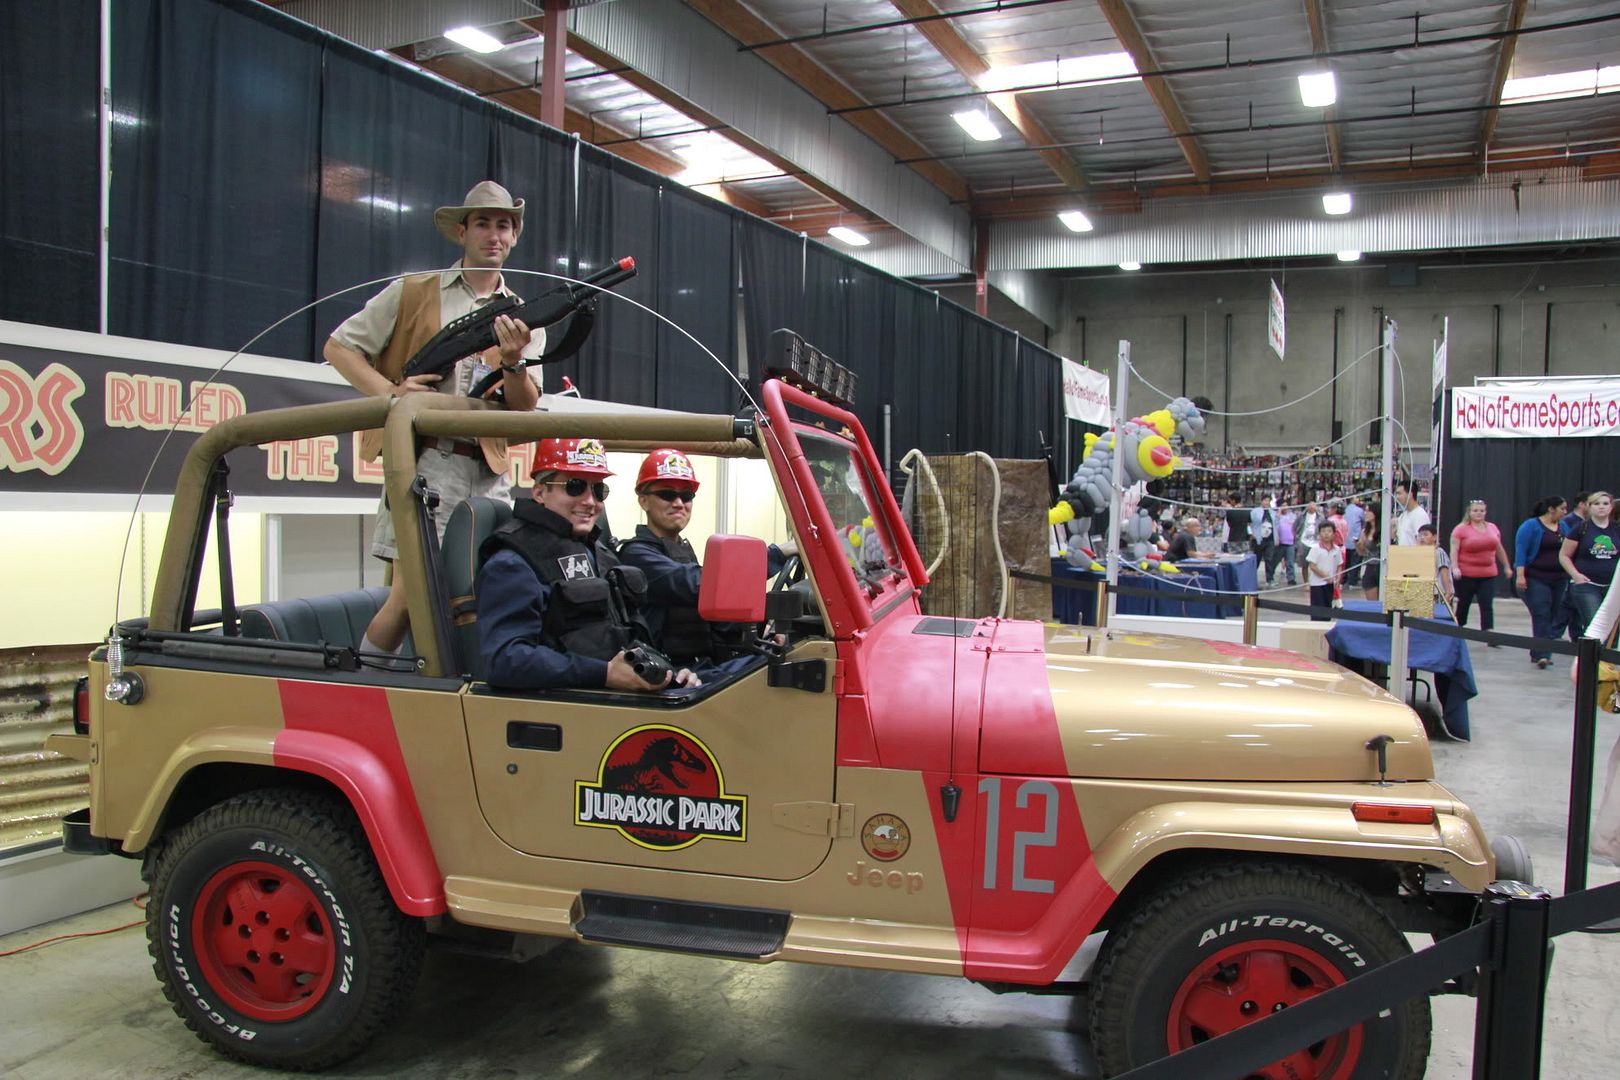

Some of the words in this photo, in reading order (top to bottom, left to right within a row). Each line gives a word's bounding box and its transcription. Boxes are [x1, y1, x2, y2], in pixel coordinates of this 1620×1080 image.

[105, 371, 247, 432] RULED
[1456, 393, 1620, 436] HallofFameSports.c
[258, 435, 339, 482] THE
[580, 788, 674, 826] JURASSIC
[678, 797, 741, 832] PARK
[978, 777, 1059, 894] 12
[250, 841, 351, 947] All-Terrain
[847, 861, 924, 895] Jeep
[1198, 915, 1367, 968] All-Terrain
[169, 904, 257, 1041] BFGoodrich
